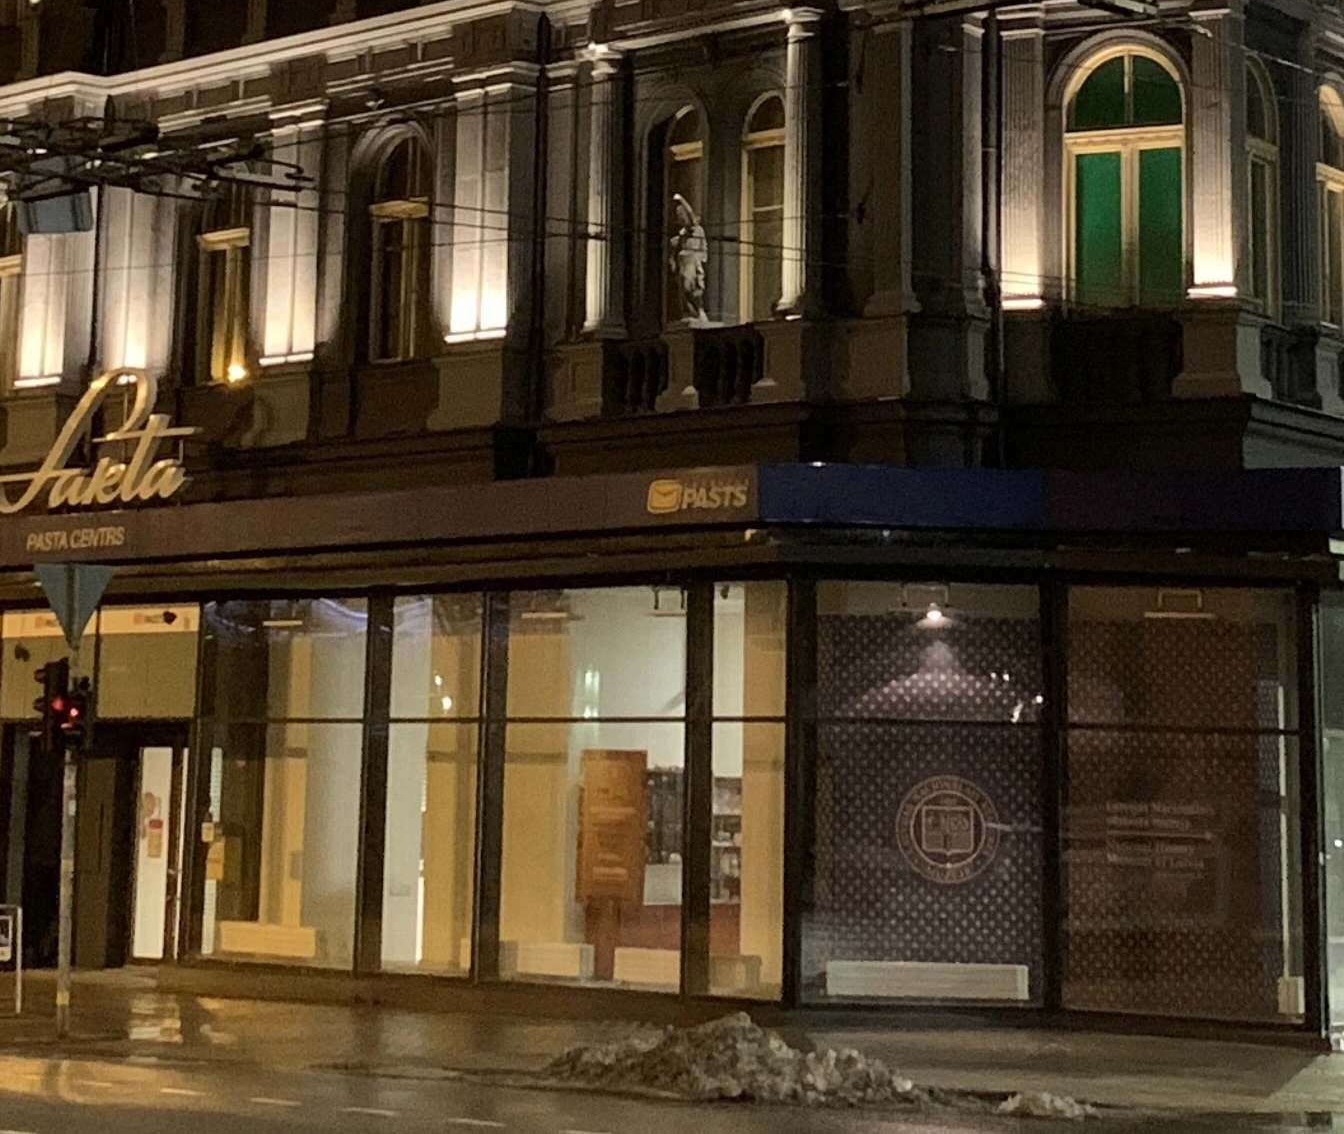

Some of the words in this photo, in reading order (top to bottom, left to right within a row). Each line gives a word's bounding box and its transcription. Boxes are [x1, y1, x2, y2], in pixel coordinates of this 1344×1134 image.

[682, 487, 748, 509] PASTS
[26, 530, 68, 552] PASTA
[70, 525, 126, 549] CENTRS
